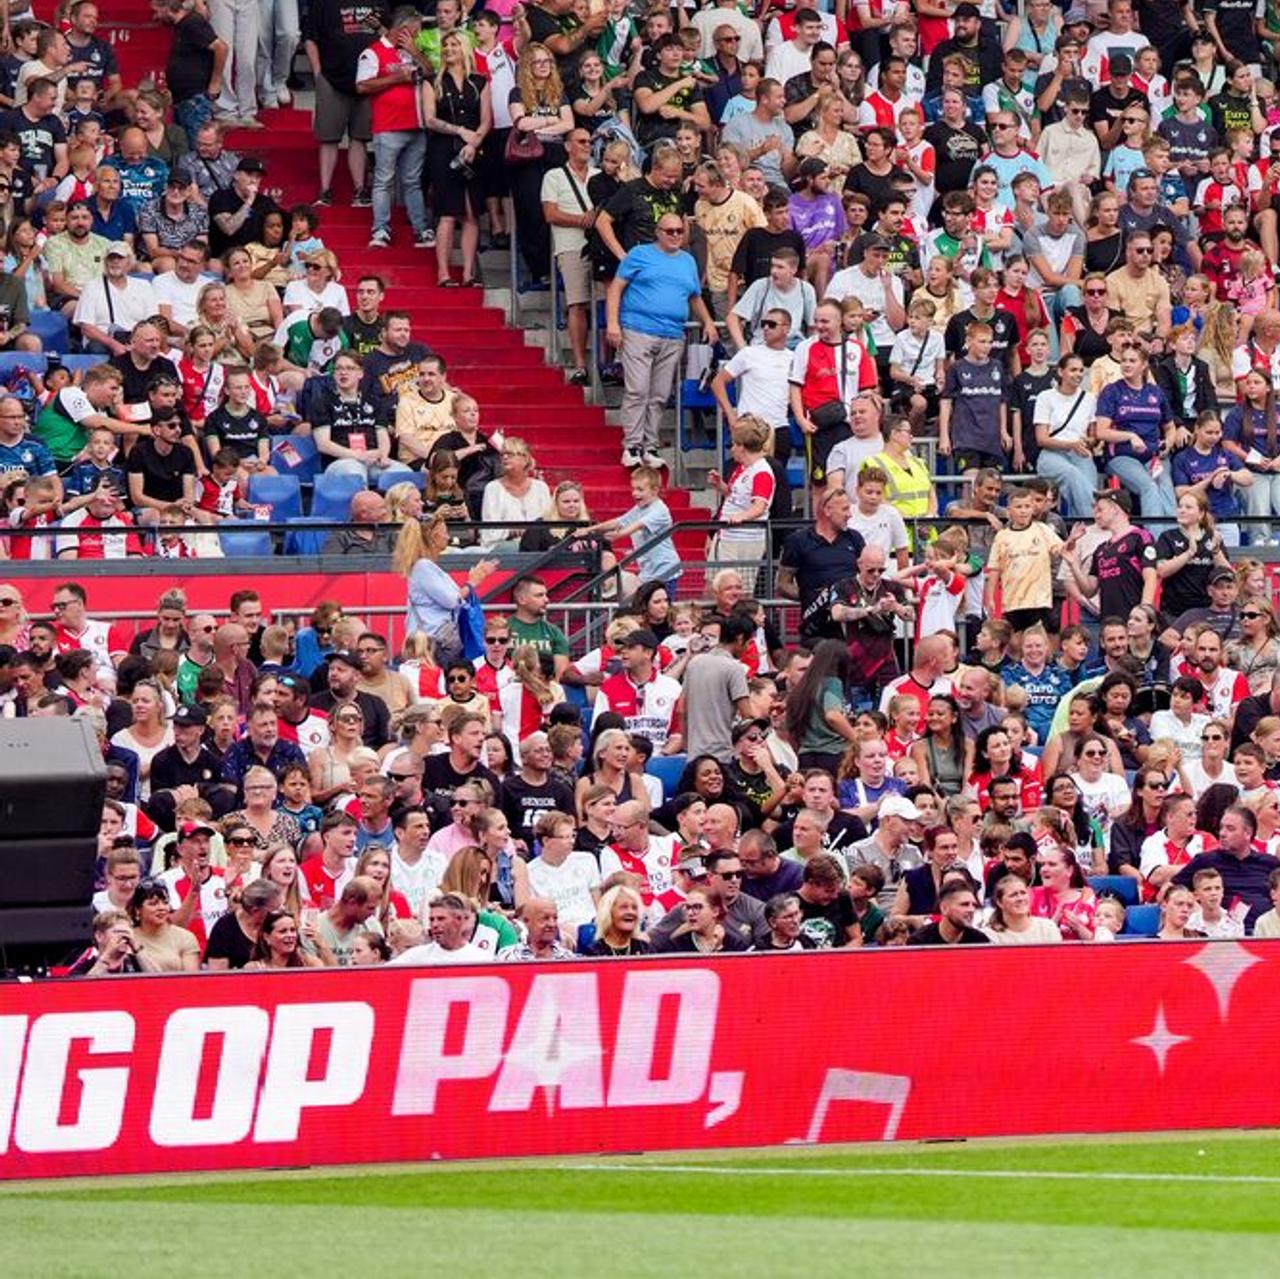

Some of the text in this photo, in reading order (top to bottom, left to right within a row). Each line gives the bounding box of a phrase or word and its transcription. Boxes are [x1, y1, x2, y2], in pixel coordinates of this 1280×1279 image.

[0, 968, 746, 1153] G OP PAD,
